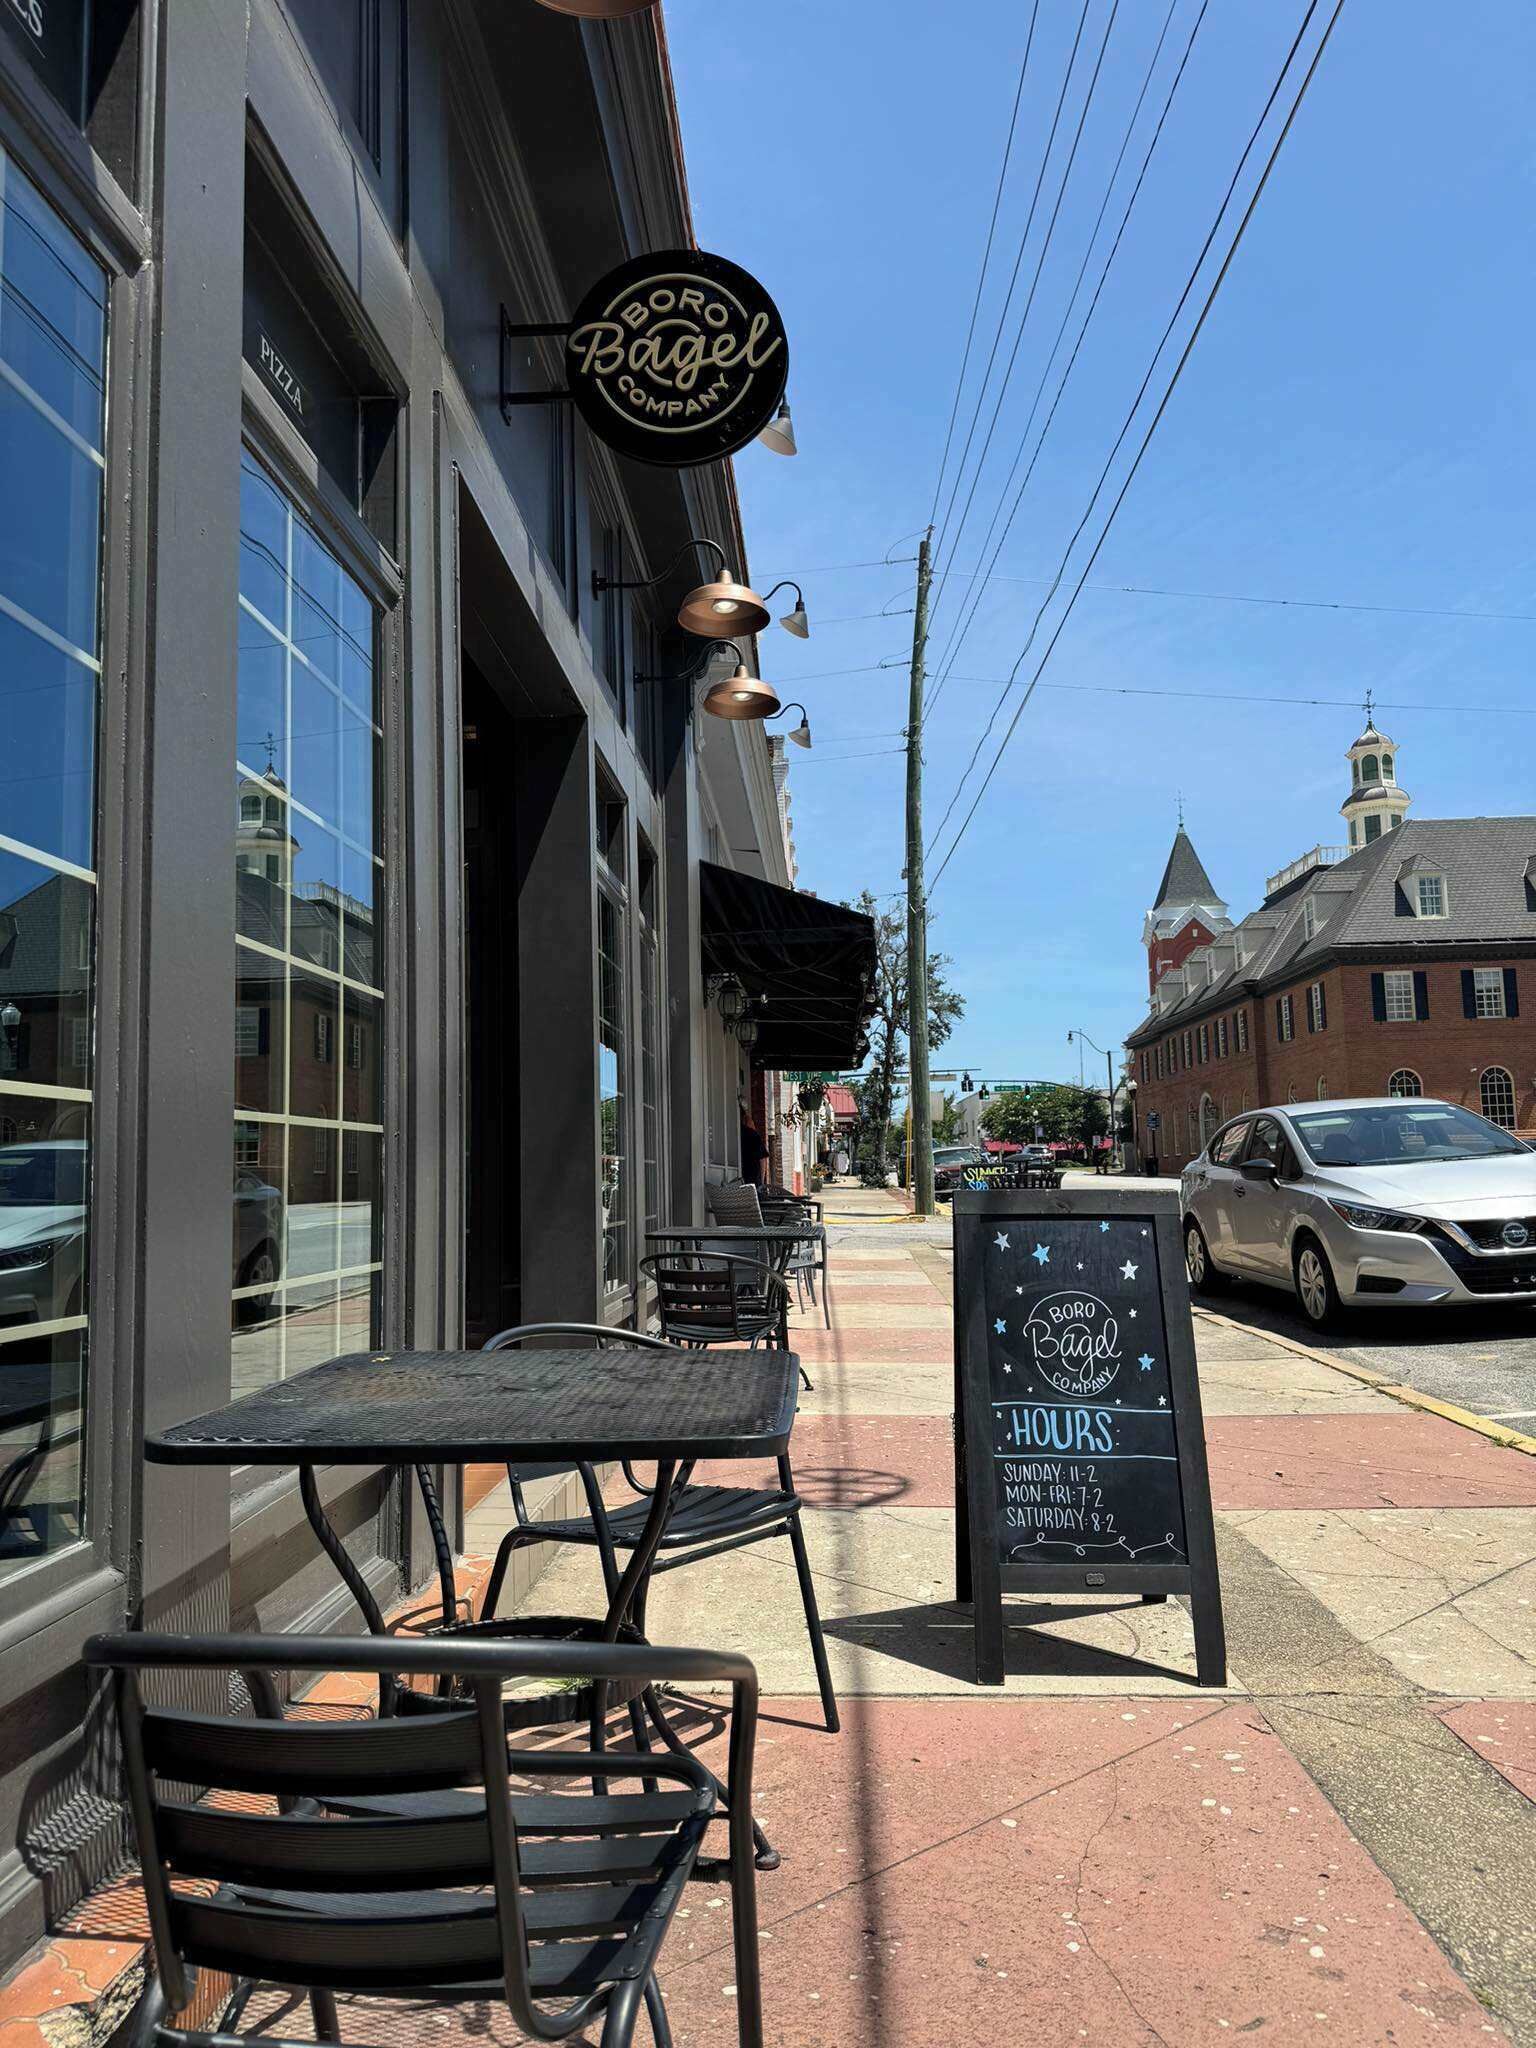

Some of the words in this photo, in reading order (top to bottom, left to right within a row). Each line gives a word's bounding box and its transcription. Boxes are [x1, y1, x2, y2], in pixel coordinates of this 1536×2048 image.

[620, 288, 729, 330] BORO
[568, 311, 782, 391] Bagel
[260, 334, 303, 415] PIZZA
[618, 373, 729, 418] COMPANY
[1048, 1301, 1096, 1324] BORO
[1023, 1317, 1122, 1384] Bagel
[1052, 1366, 1113, 1394] COMPANY
[1003, 1462, 1066, 1484] SUNDAY:
[1069, 1464, 1099, 1483] 11-2
[1076, 1486, 1104, 1508] 7-2
[1006, 1506, 1089, 1531] SATURDAY:
[1091, 1512, 1117, 1533] 8-2
